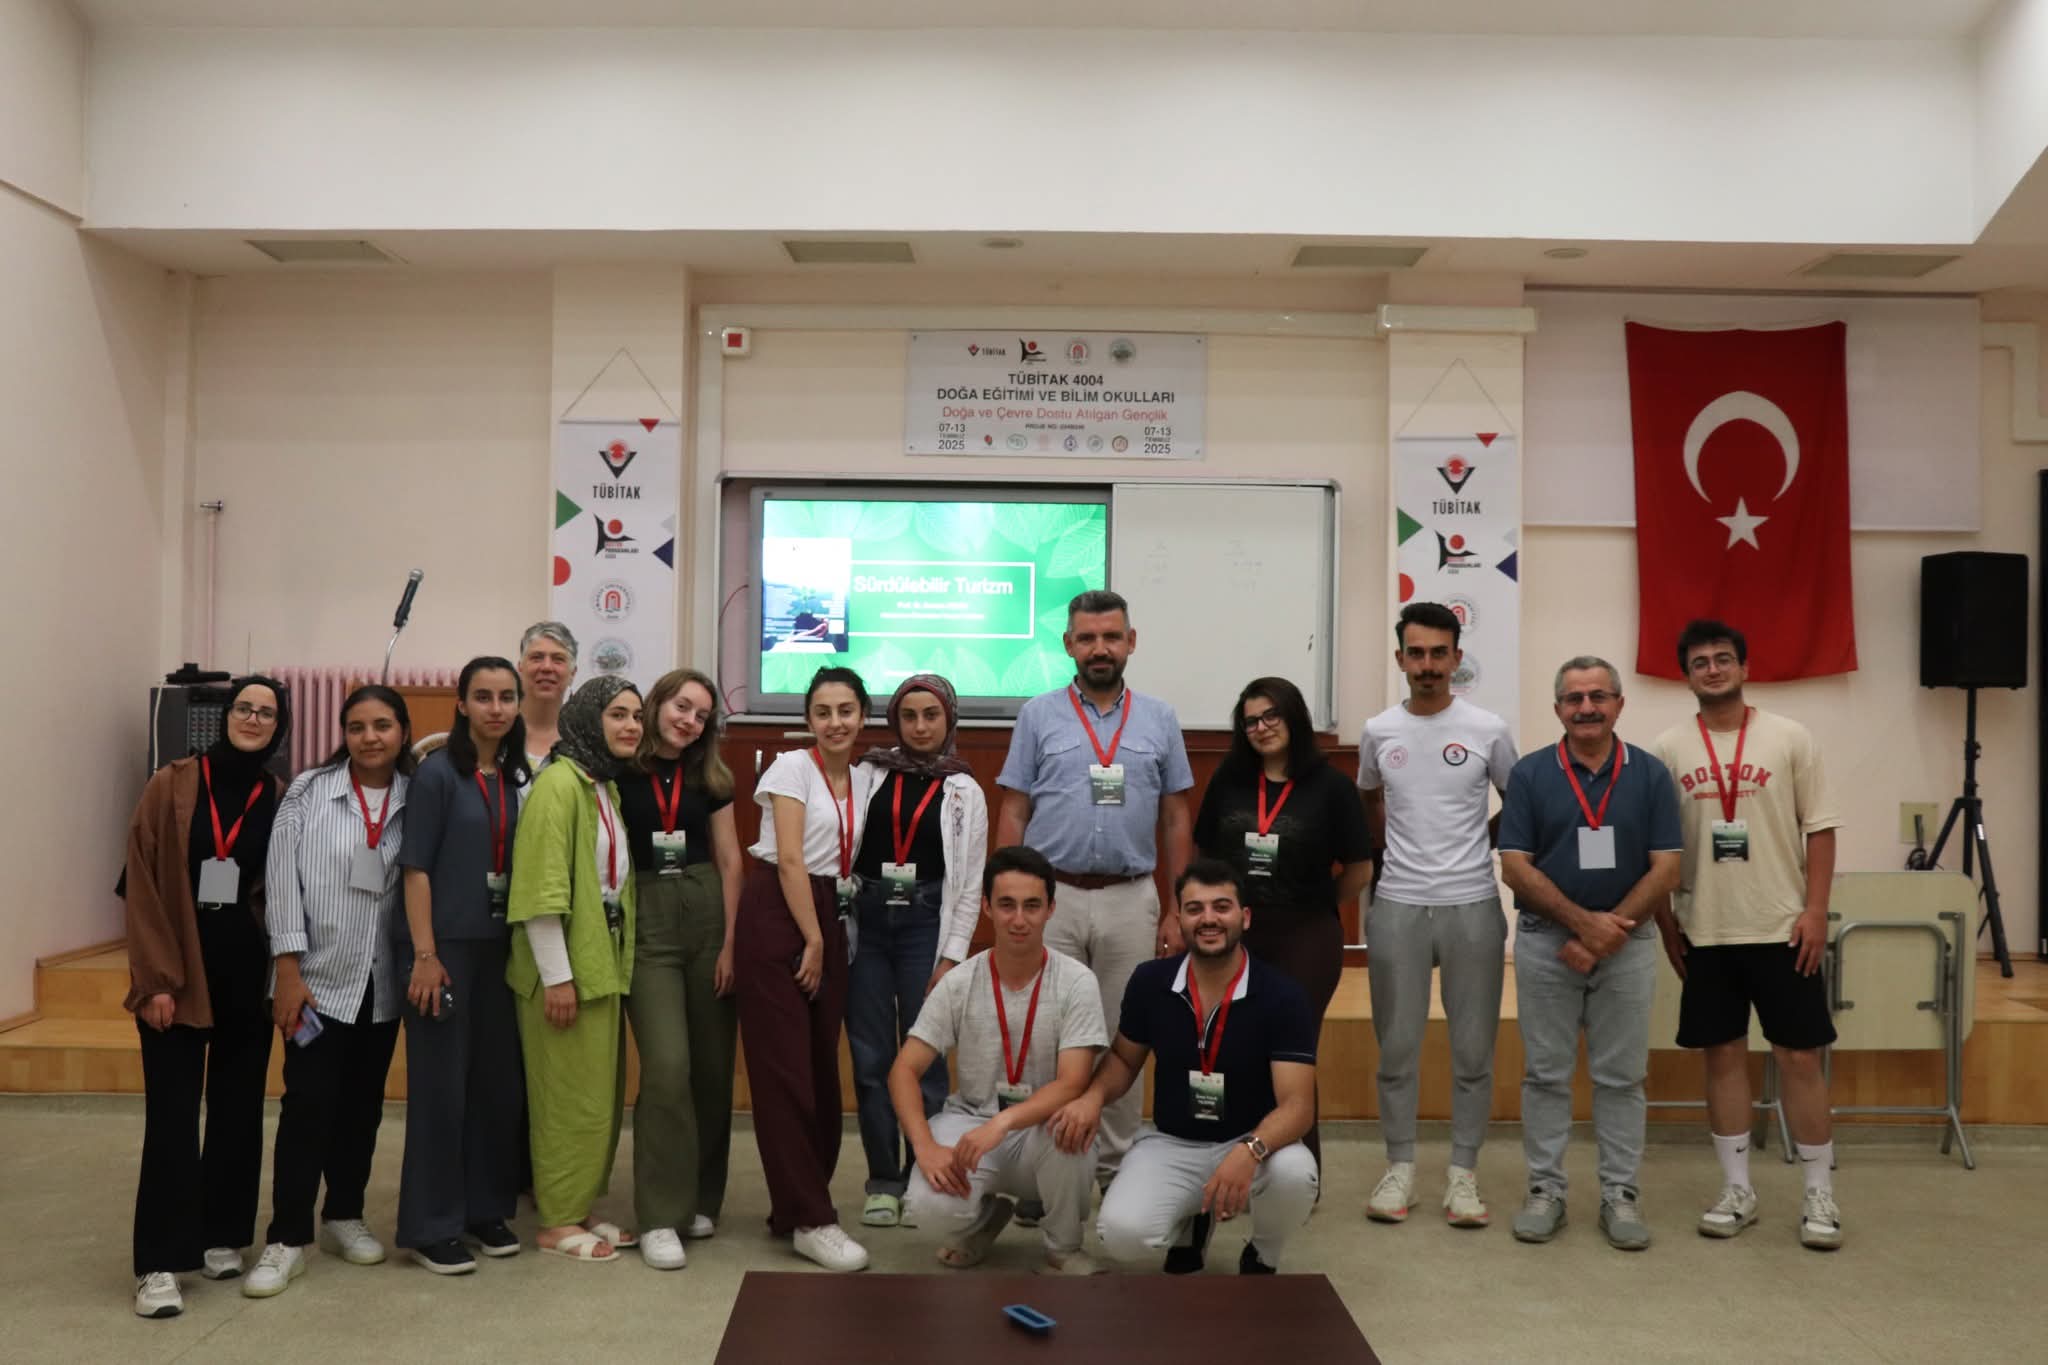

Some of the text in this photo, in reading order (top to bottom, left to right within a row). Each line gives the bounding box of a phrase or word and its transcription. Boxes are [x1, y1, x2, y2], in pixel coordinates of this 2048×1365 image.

[1008, 370, 1104, 386] TÜBİTAK 4004
[937, 386, 1175, 404] DOĞA EĞİTİMİ VE BİLİM OKULLARI
[942, 406, 1168, 422] Doğa ve Çevre Dostu Atılgan Gençlik
[938, 423, 966, 433] 07-13
[1144, 426, 1171, 436] 07-13
[938, 439, 965, 450] 2025
[1143, 443, 1172, 454] 2025
[593, 483, 641, 499] TÜBİTAK
[1432, 499, 1481, 515] TÜBİTAK
